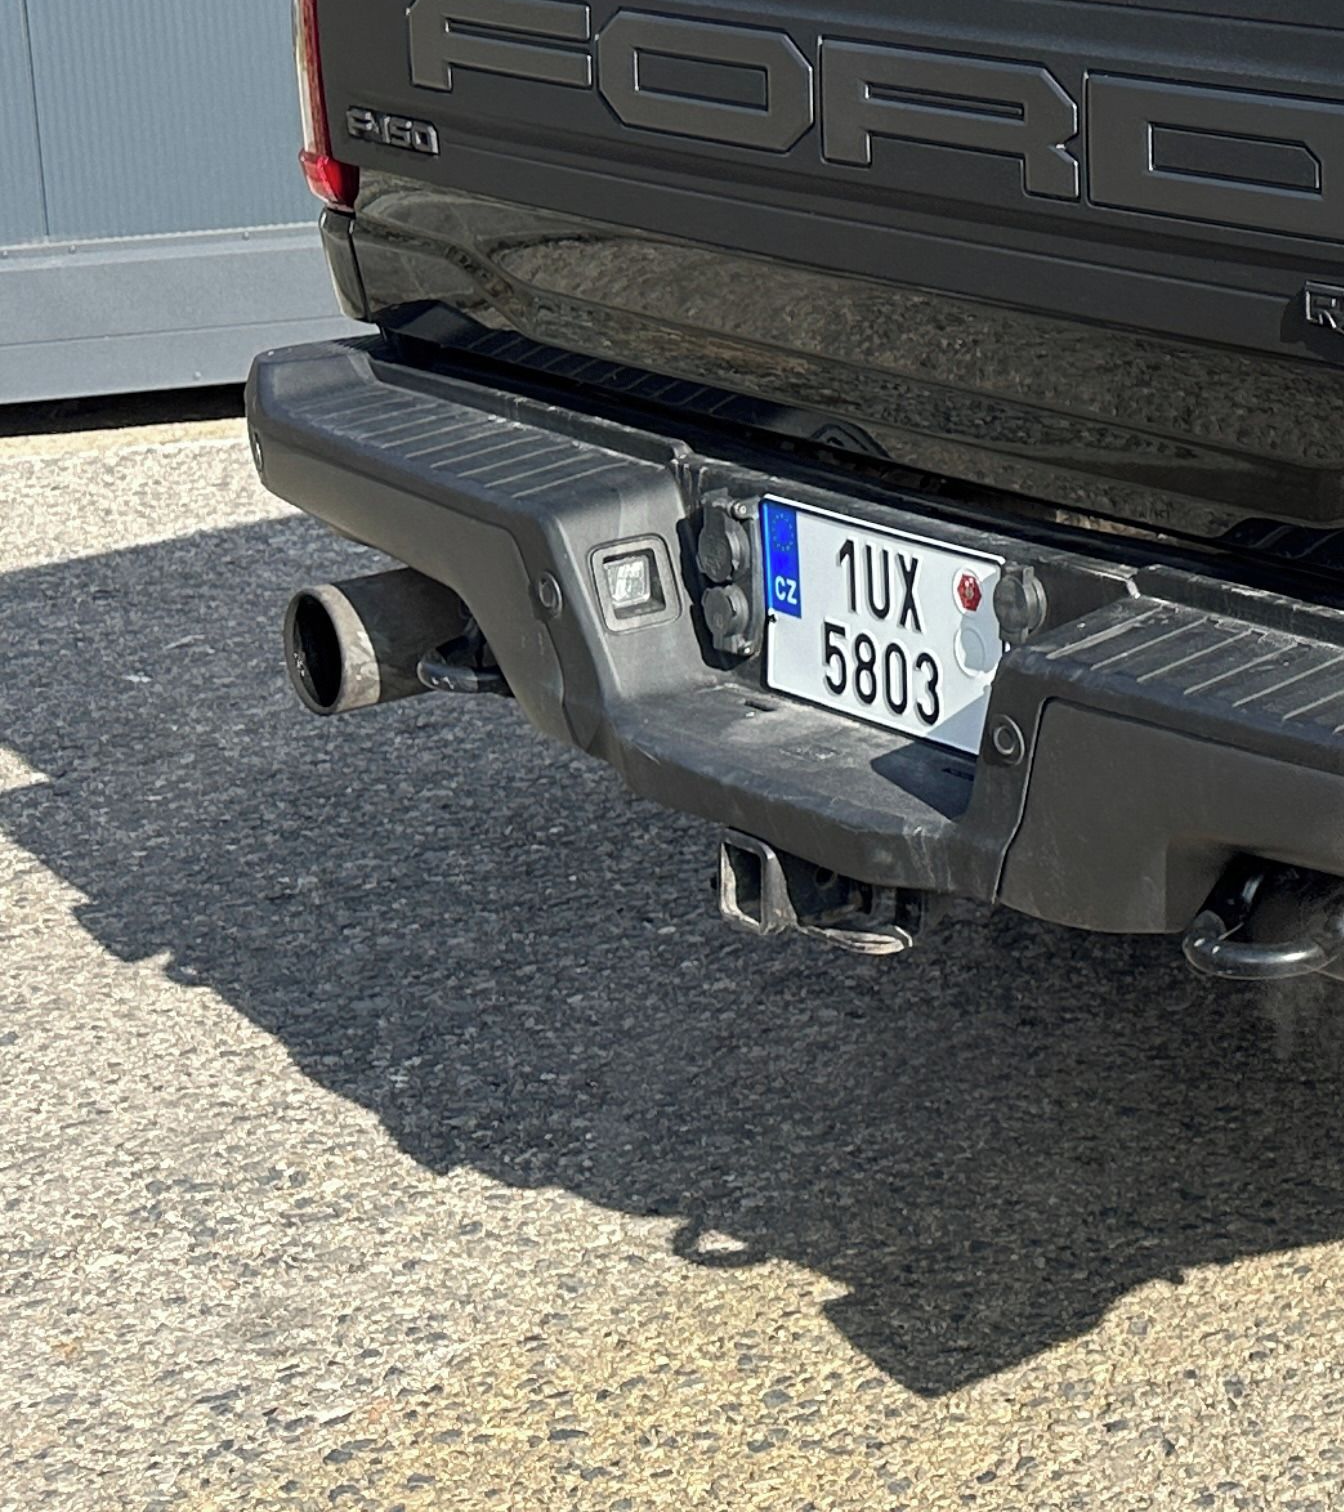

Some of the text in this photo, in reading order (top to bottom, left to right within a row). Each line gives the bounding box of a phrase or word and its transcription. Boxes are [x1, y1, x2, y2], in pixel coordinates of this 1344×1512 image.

[774, 574, 798, 605] CZ
[838, 539, 922, 633] 1UX
[822, 620, 941, 727] 5803
